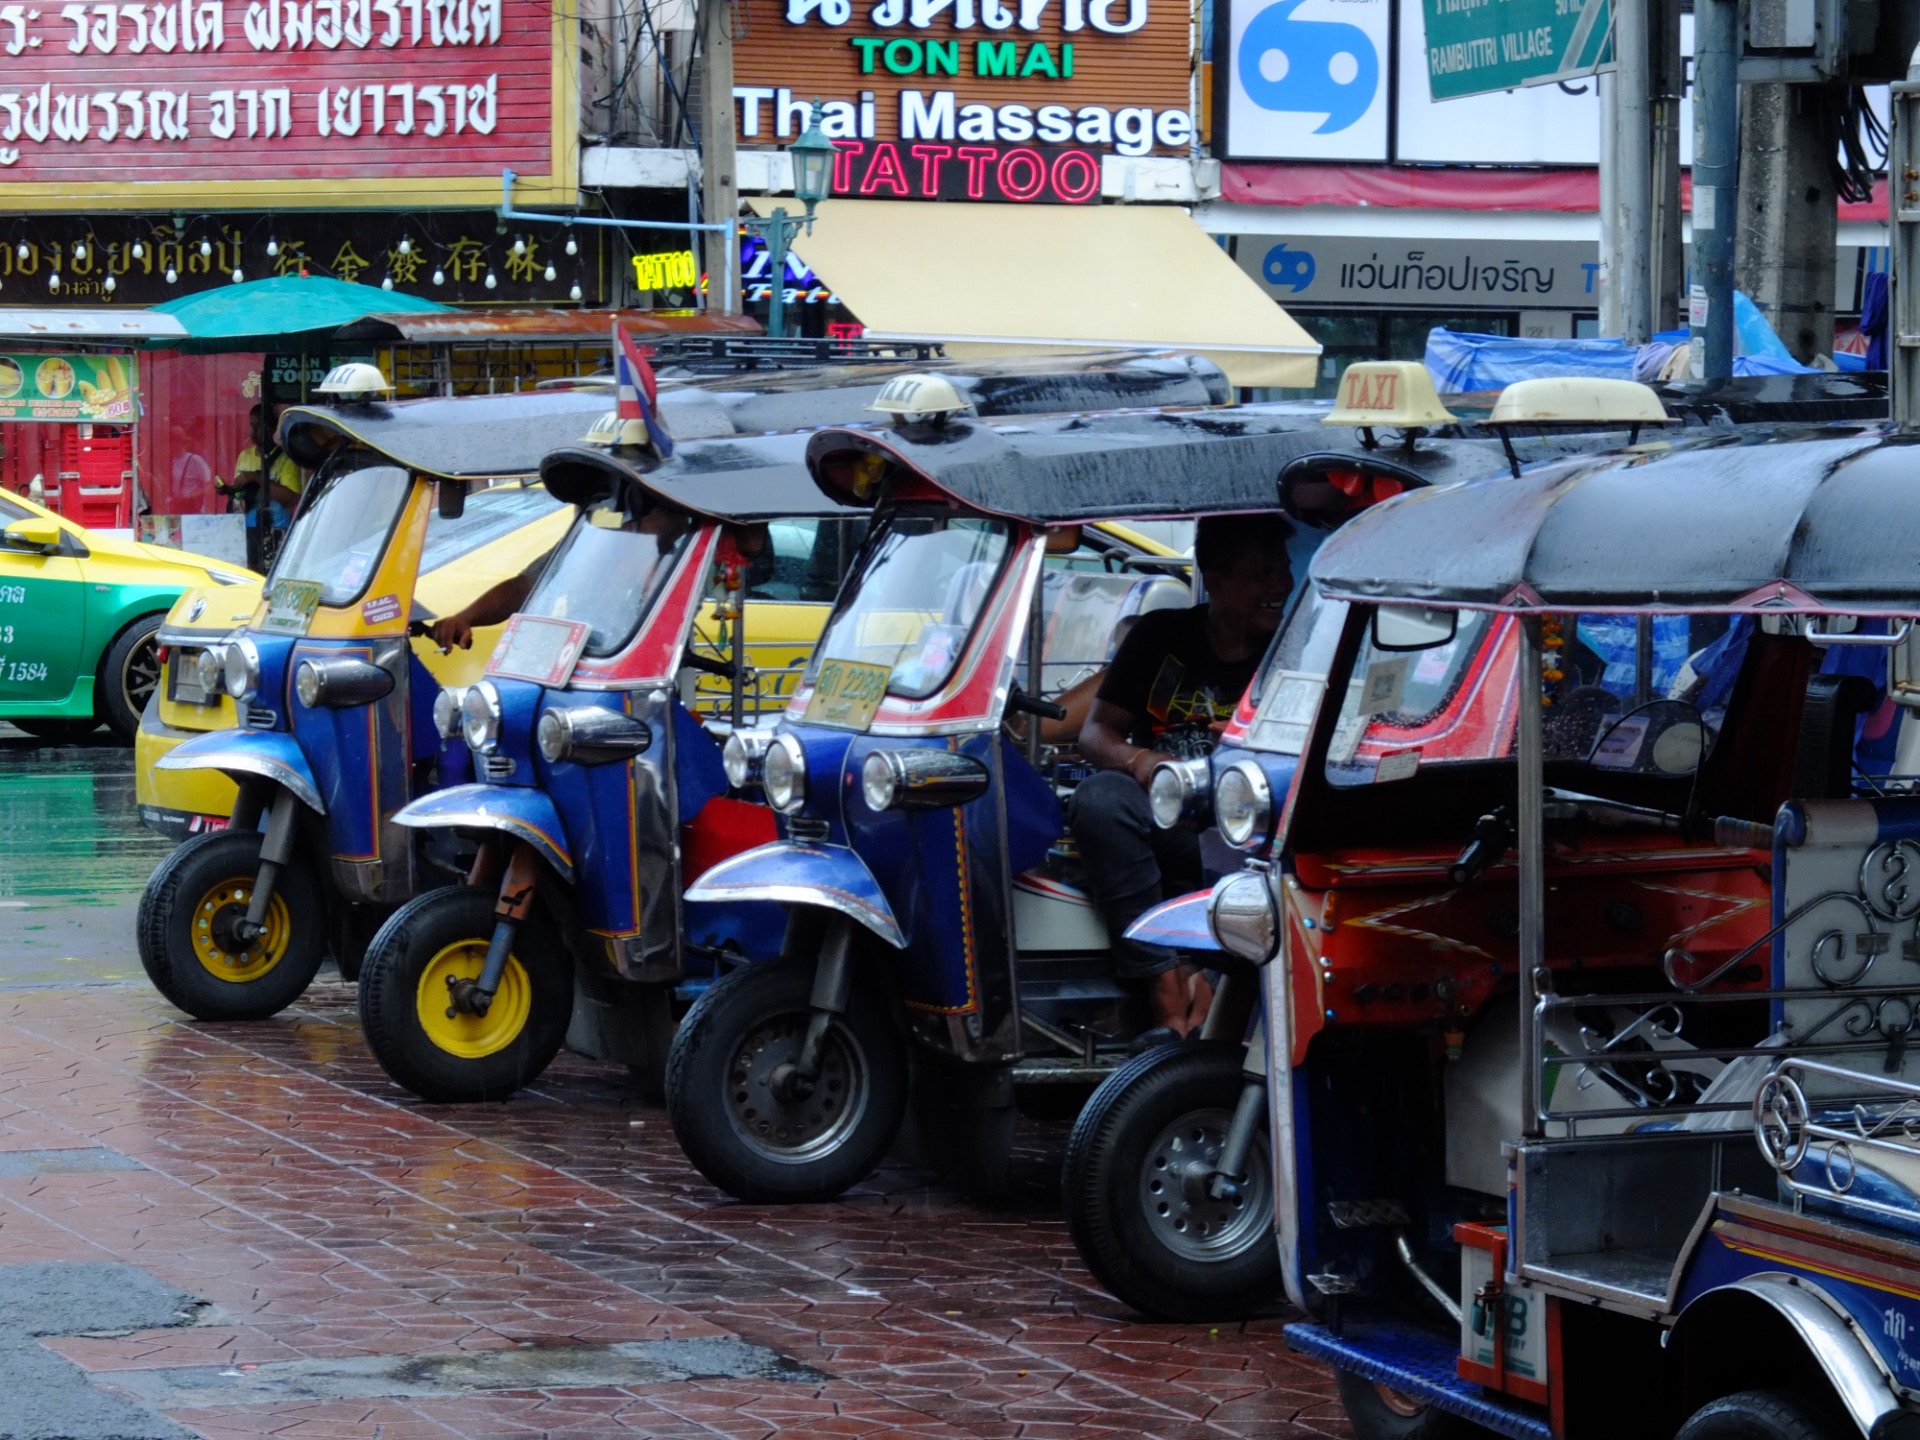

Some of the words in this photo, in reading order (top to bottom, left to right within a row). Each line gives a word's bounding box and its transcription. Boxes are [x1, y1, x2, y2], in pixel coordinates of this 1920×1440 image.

[852, 38, 959, 75] TON
[976, 41, 1074, 78] MAI
[1431, 37, 1498, 76] RAMBUTTRI
[1501, 26, 1553, 63] VILLAGE
[208, 89, 292, 139] จาก
[318, 73, 497, 137] เยาวราช
[732, 86, 875, 139] Thai
[901, 90, 1192, 156] Massage
[830, 140, 1100, 202] TATTOO
[632, 250, 696, 291] TATTOO
[1340, 251, 1555, 294] แว่นท็อปเจริญ
[878, 379, 923, 404] TAXI
[1345, 373, 1398, 410] TAXI
[8, 661, 48, 681] 1584
